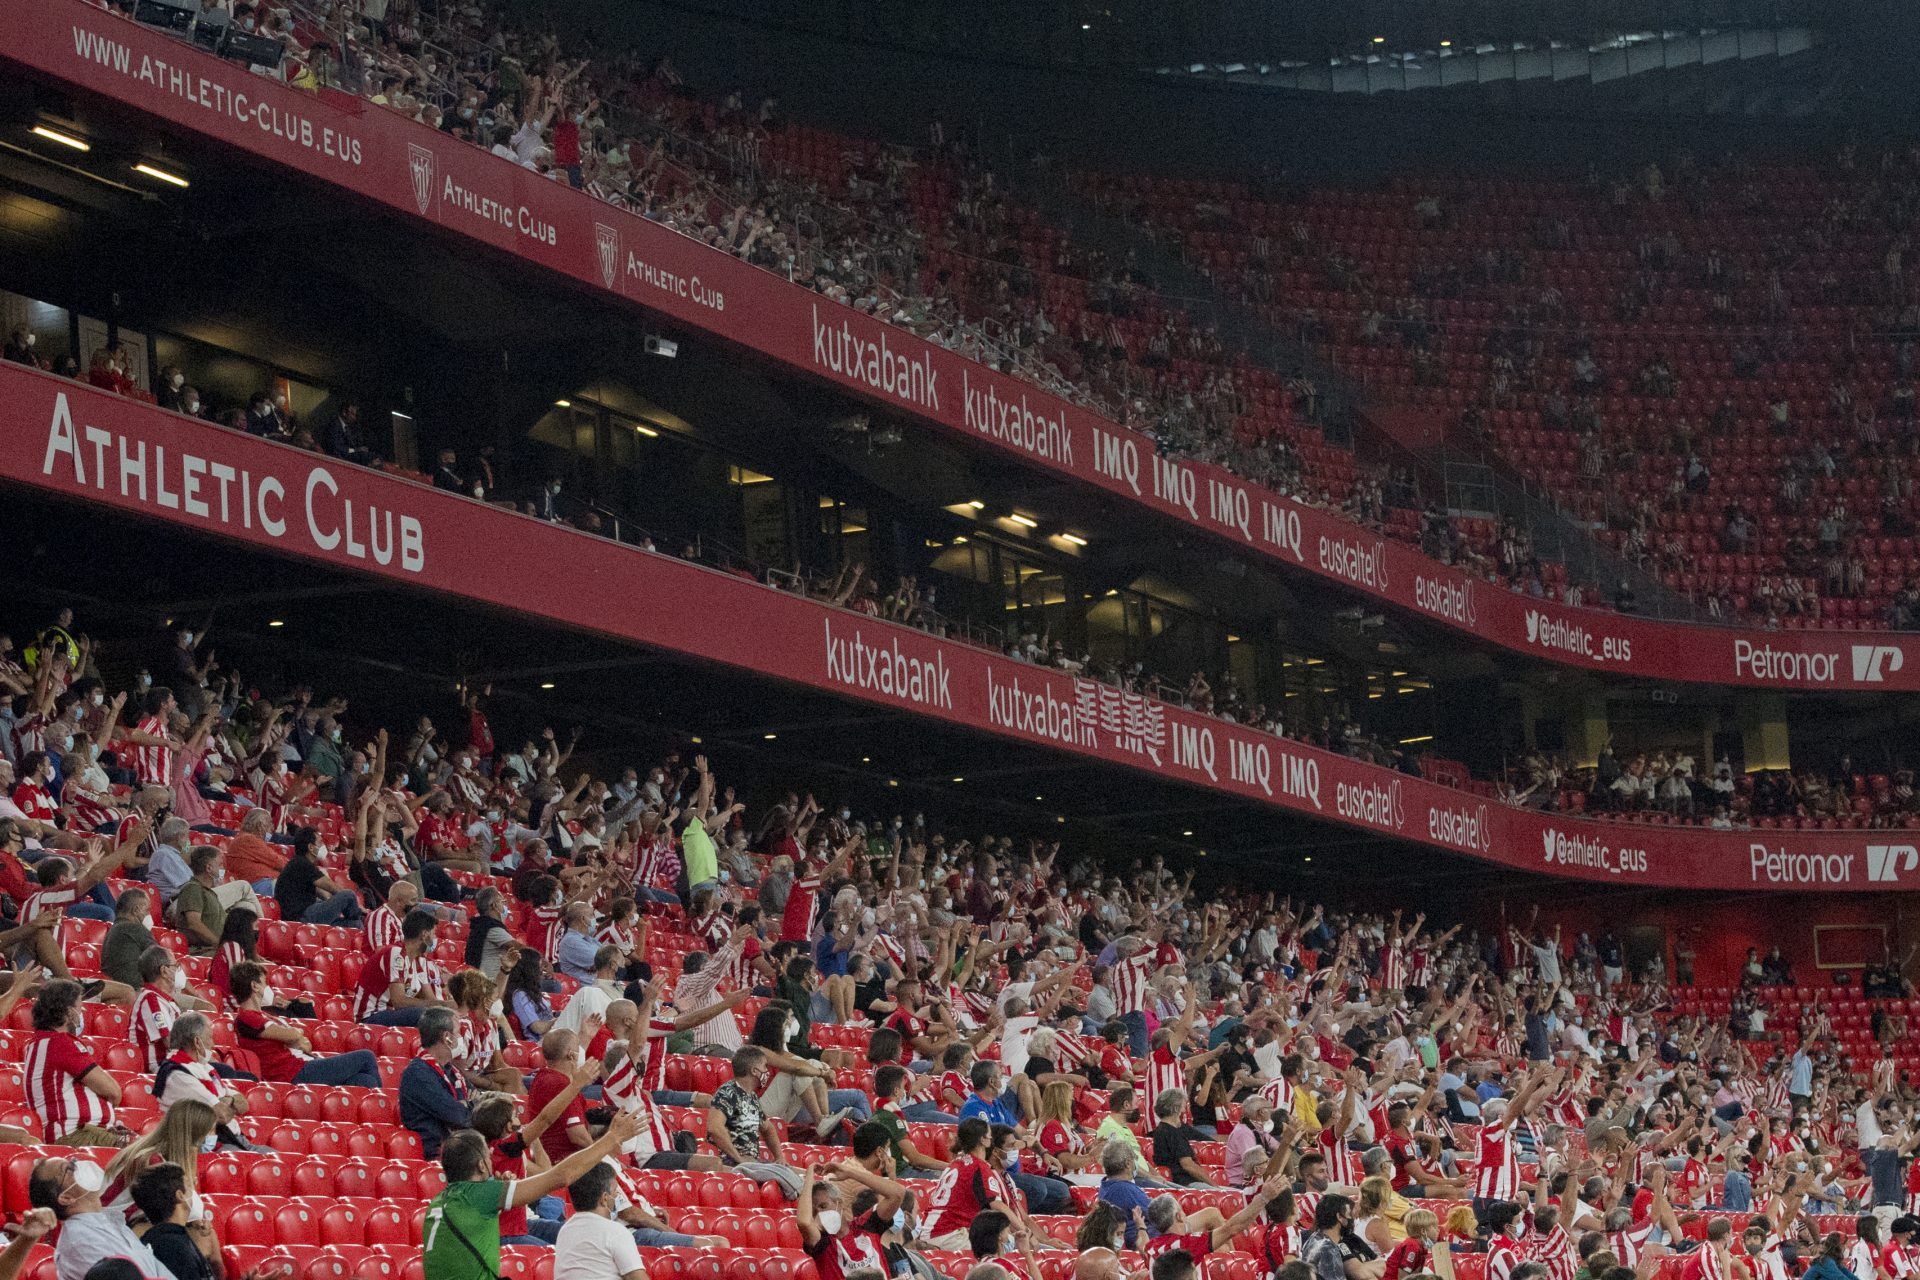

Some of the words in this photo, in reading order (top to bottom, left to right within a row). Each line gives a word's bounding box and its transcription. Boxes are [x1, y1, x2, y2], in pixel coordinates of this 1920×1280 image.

[812, 304, 938, 410] kutxabank
[963, 370, 1073, 466] kutxabank
[1093, 425, 1142, 496] IMQ
[1152, 454, 1199, 520] IMQ
[1209, 479, 1253, 541] IMQ
[1262, 501, 1304, 562] IMQ
[1319, 536, 1375, 586] euskaltel
[1415, 575, 1465, 622] euskaltel
[825, 618, 952, 709] kutxabank
[1734, 639, 1839, 682] Petronor
[1172, 722, 1218, 782] IMQ
[1229, 738, 1273, 796] IMQ
[1281, 753, 1322, 810] IMQ
[1337, 782, 1390, 825] euskaltel
[1429, 807, 1477, 849] euskaltel
[1750, 843, 1854, 883] Petronor
